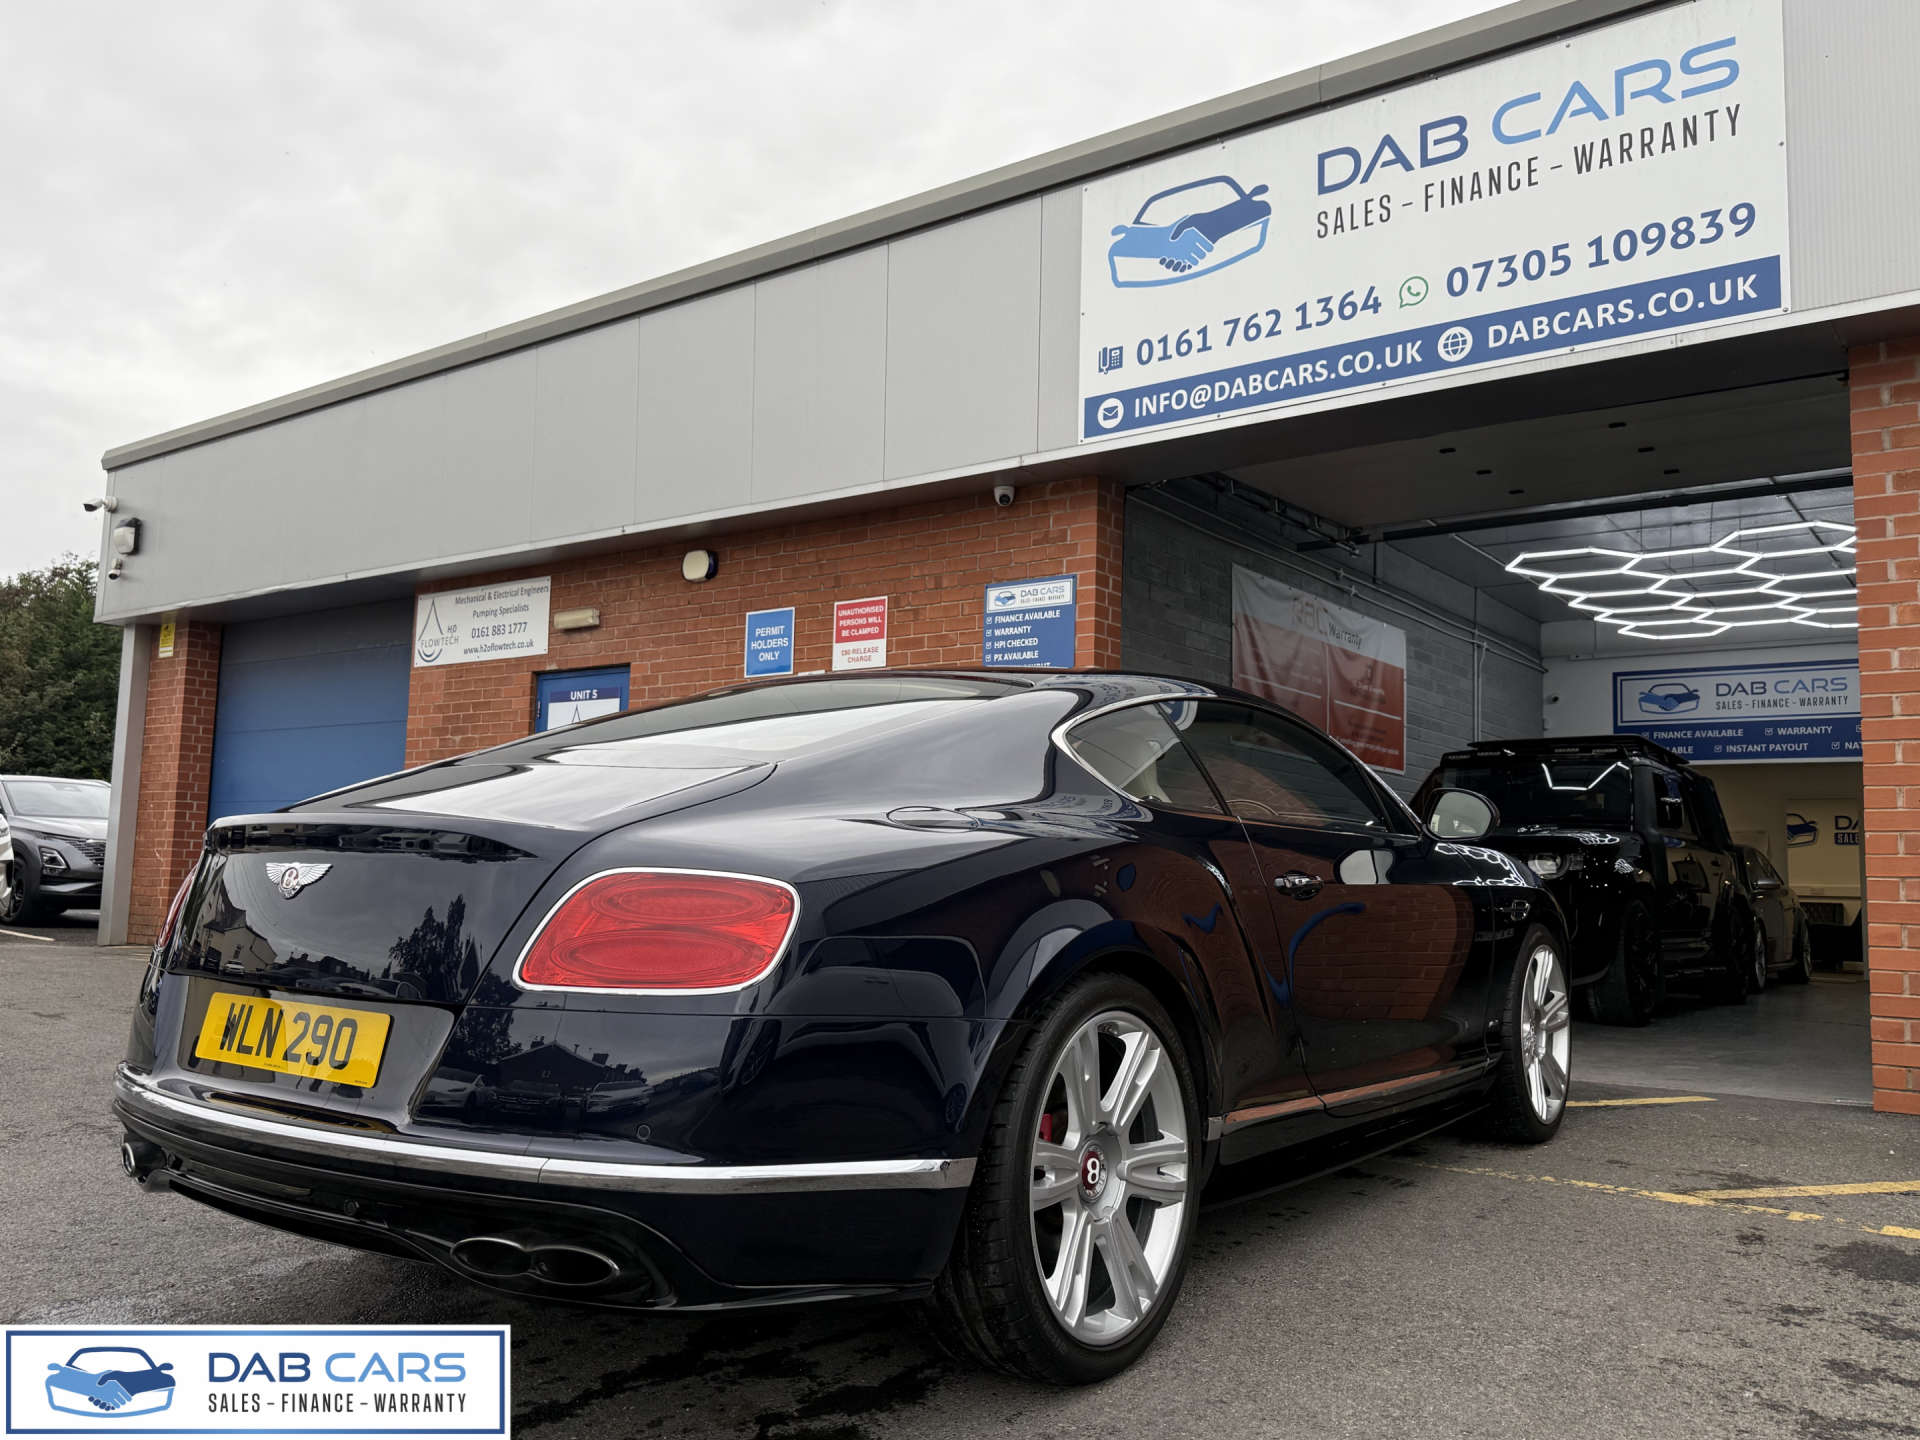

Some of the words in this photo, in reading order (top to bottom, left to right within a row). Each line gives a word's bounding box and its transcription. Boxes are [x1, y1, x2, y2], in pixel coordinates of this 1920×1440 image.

[1316, 114, 1469, 196] DAB
[1491, 36, 1740, 146] CARS
[1316, 194, 1392, 240] SALES
[1423, 156, 1540, 213] FINANCE
[1573, 104, 1742, 175] WARRANTY
[1446, 242, 1571, 298] 07305
[1587, 202, 1756, 270] 109839
[1487, 273, 1758, 349] DABCARS.CO.UK
[1136, 325, 1213, 367] 0161
[1223, 308, 1283, 349] 762
[1294, 285, 1382, 332] 1364
[1133, 339, 1423, 419] INFO@DABCARS.CO.UK
[455, 591, 487, 605] Mechanical
[493, 588, 519, 600] Electrical
[1020, 588, 1039, 598] DAB
[1040, 585, 1065, 596] CARS
[472, 608, 498, 618] Pumping
[838, 605, 884, 617] UNAUTHORISED
[994, 613, 1023, 624] FINANCE
[1024, 609, 1061, 620] AVAILABLE
[839, 619, 866, 627] PERSONS
[867, 616, 882, 624] WILL
[471, 626, 490, 639] 0161
[491, 624, 506, 637] 883
[508, 621, 528, 634] 1777
[755, 625, 785, 637] PERMIT
[850, 626, 879, 636] CLAMPED
[994, 625, 1032, 637] WARRANTY
[751, 637, 789, 650] HOLDERS
[994, 641, 1006, 649] HPI
[1007, 637, 1039, 647] CHECKED
[758, 650, 781, 662] ONLY
[993, 654, 1003, 662] PX
[1003, 650, 1040, 661] AVAILABLE
[1715, 681, 1768, 697] DAB
[1774, 677, 1848, 693] CARS
[570, 690, 590, 700] UNIT
[1715, 700, 1743, 711] SALES
[1752, 698, 1790, 709] FINANCE
[1799, 695, 1849, 707] WARRANTY
[1653, 730, 1693, 739] FINANCE
[1694, 728, 1744, 738] AVAILABLE
[1777, 726, 1833, 736] WARRANTY
[1726, 744, 1767, 753] INSTANT
[1769, 742, 1809, 752] PAYOUT
[219, 1002, 284, 1058] WLN
[283, 1011, 358, 1070] 290
